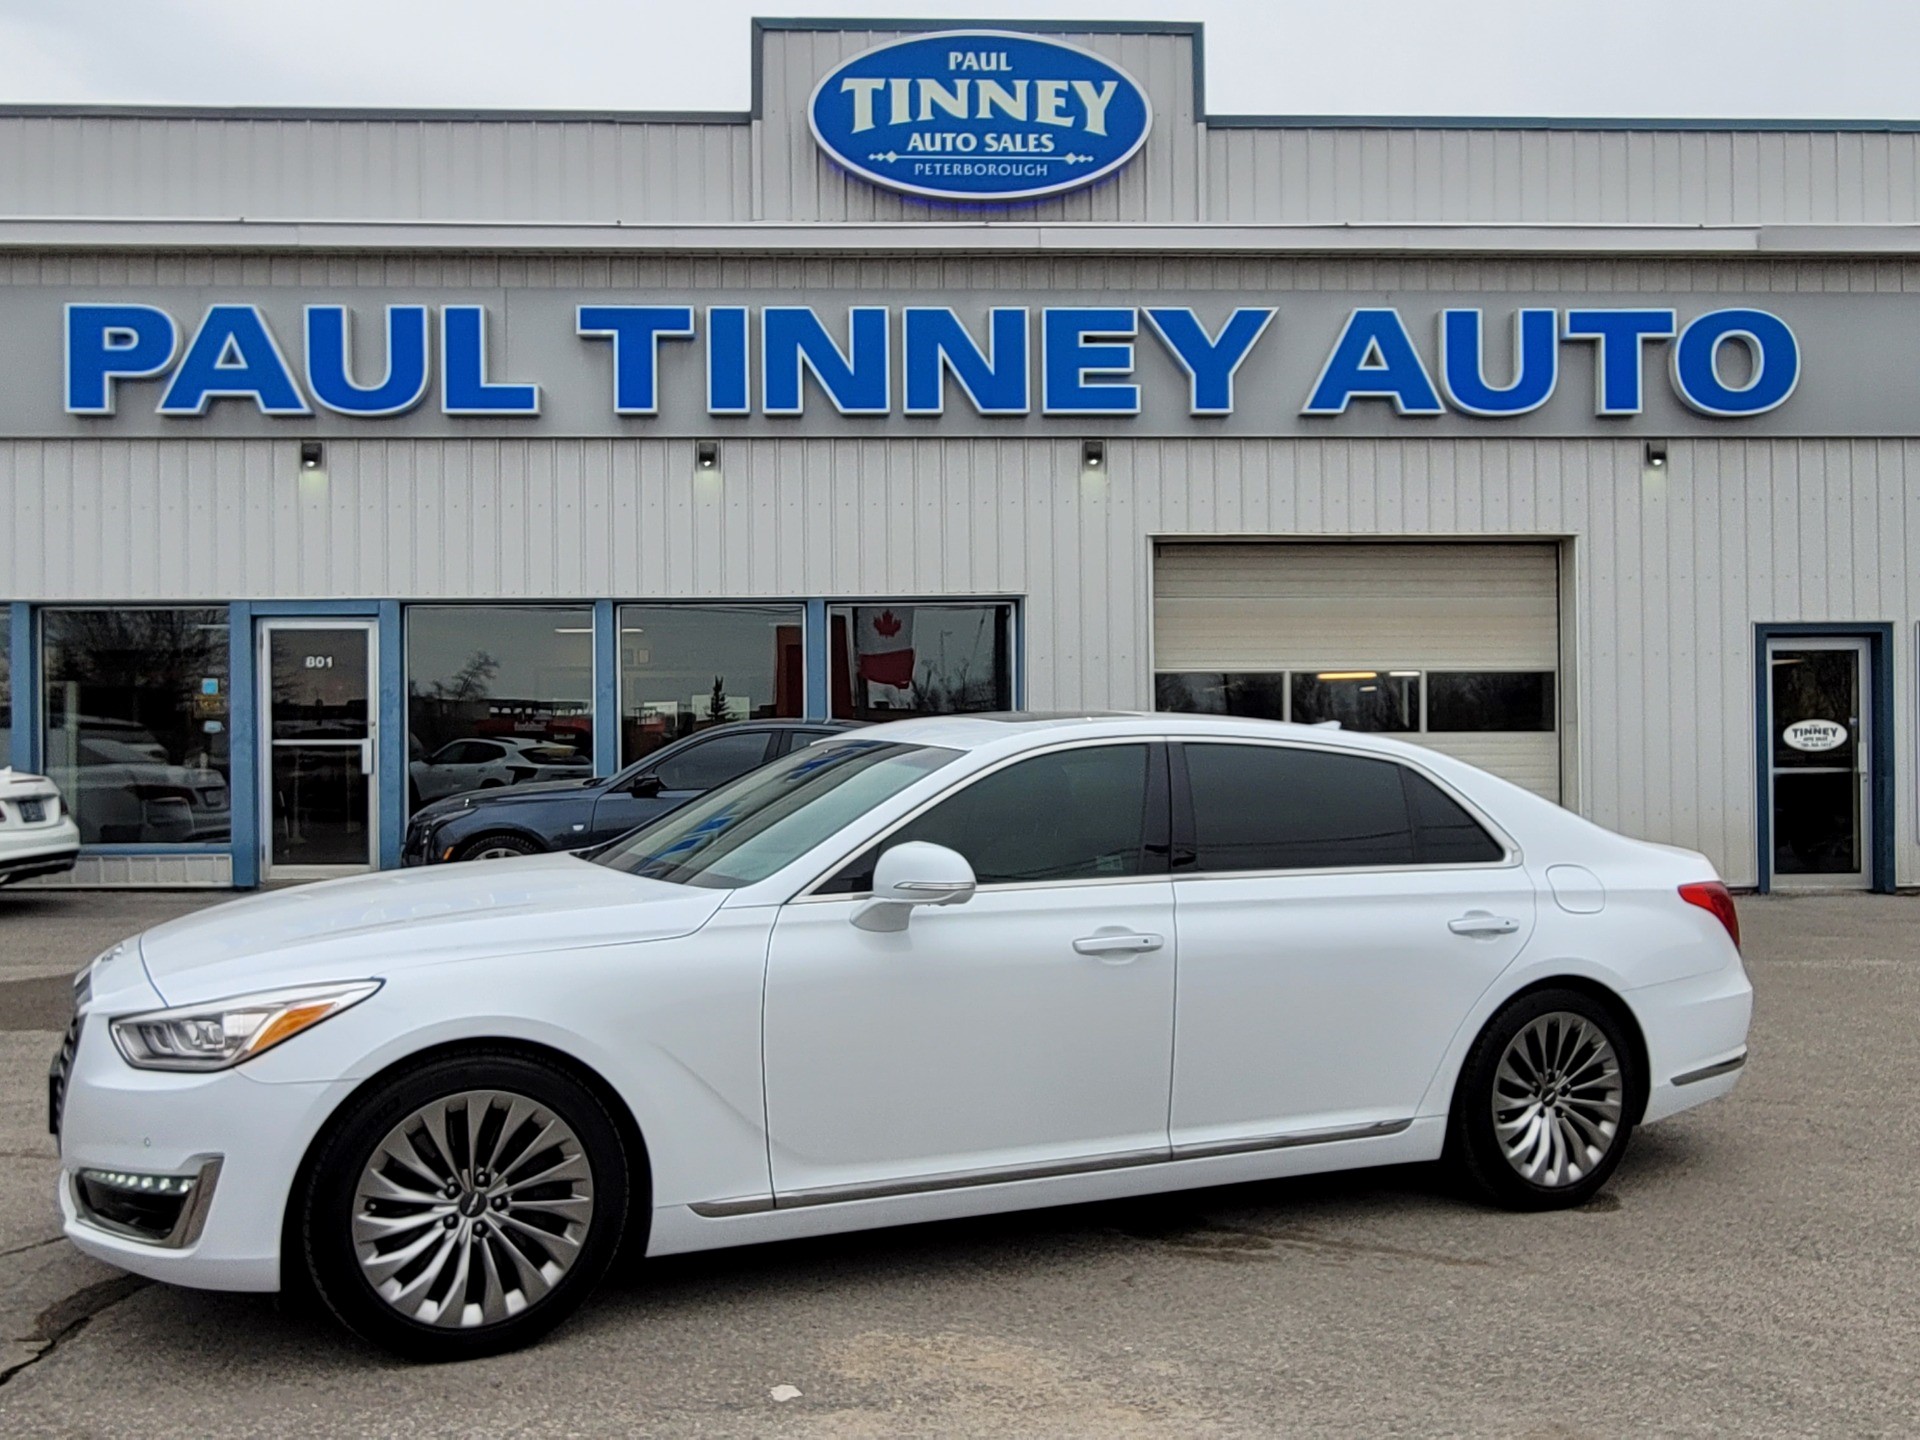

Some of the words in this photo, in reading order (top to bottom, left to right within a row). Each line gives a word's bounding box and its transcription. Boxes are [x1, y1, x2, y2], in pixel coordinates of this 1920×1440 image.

[948, 52, 1013, 72] PAUL
[840, 77, 1119, 137] TINNEY
[907, 132, 978, 152] AUTO
[984, 133, 1055, 153] SALES
[914, 163, 1048, 177] PETERBOROUGH
[64, 303, 541, 417] PAUL
[575, 304, 1280, 417] TINNEY
[1300, 307, 1802, 418] AUTO
[305, 655, 333, 669] 801
[1791, 727, 1838, 739] TINNEY
